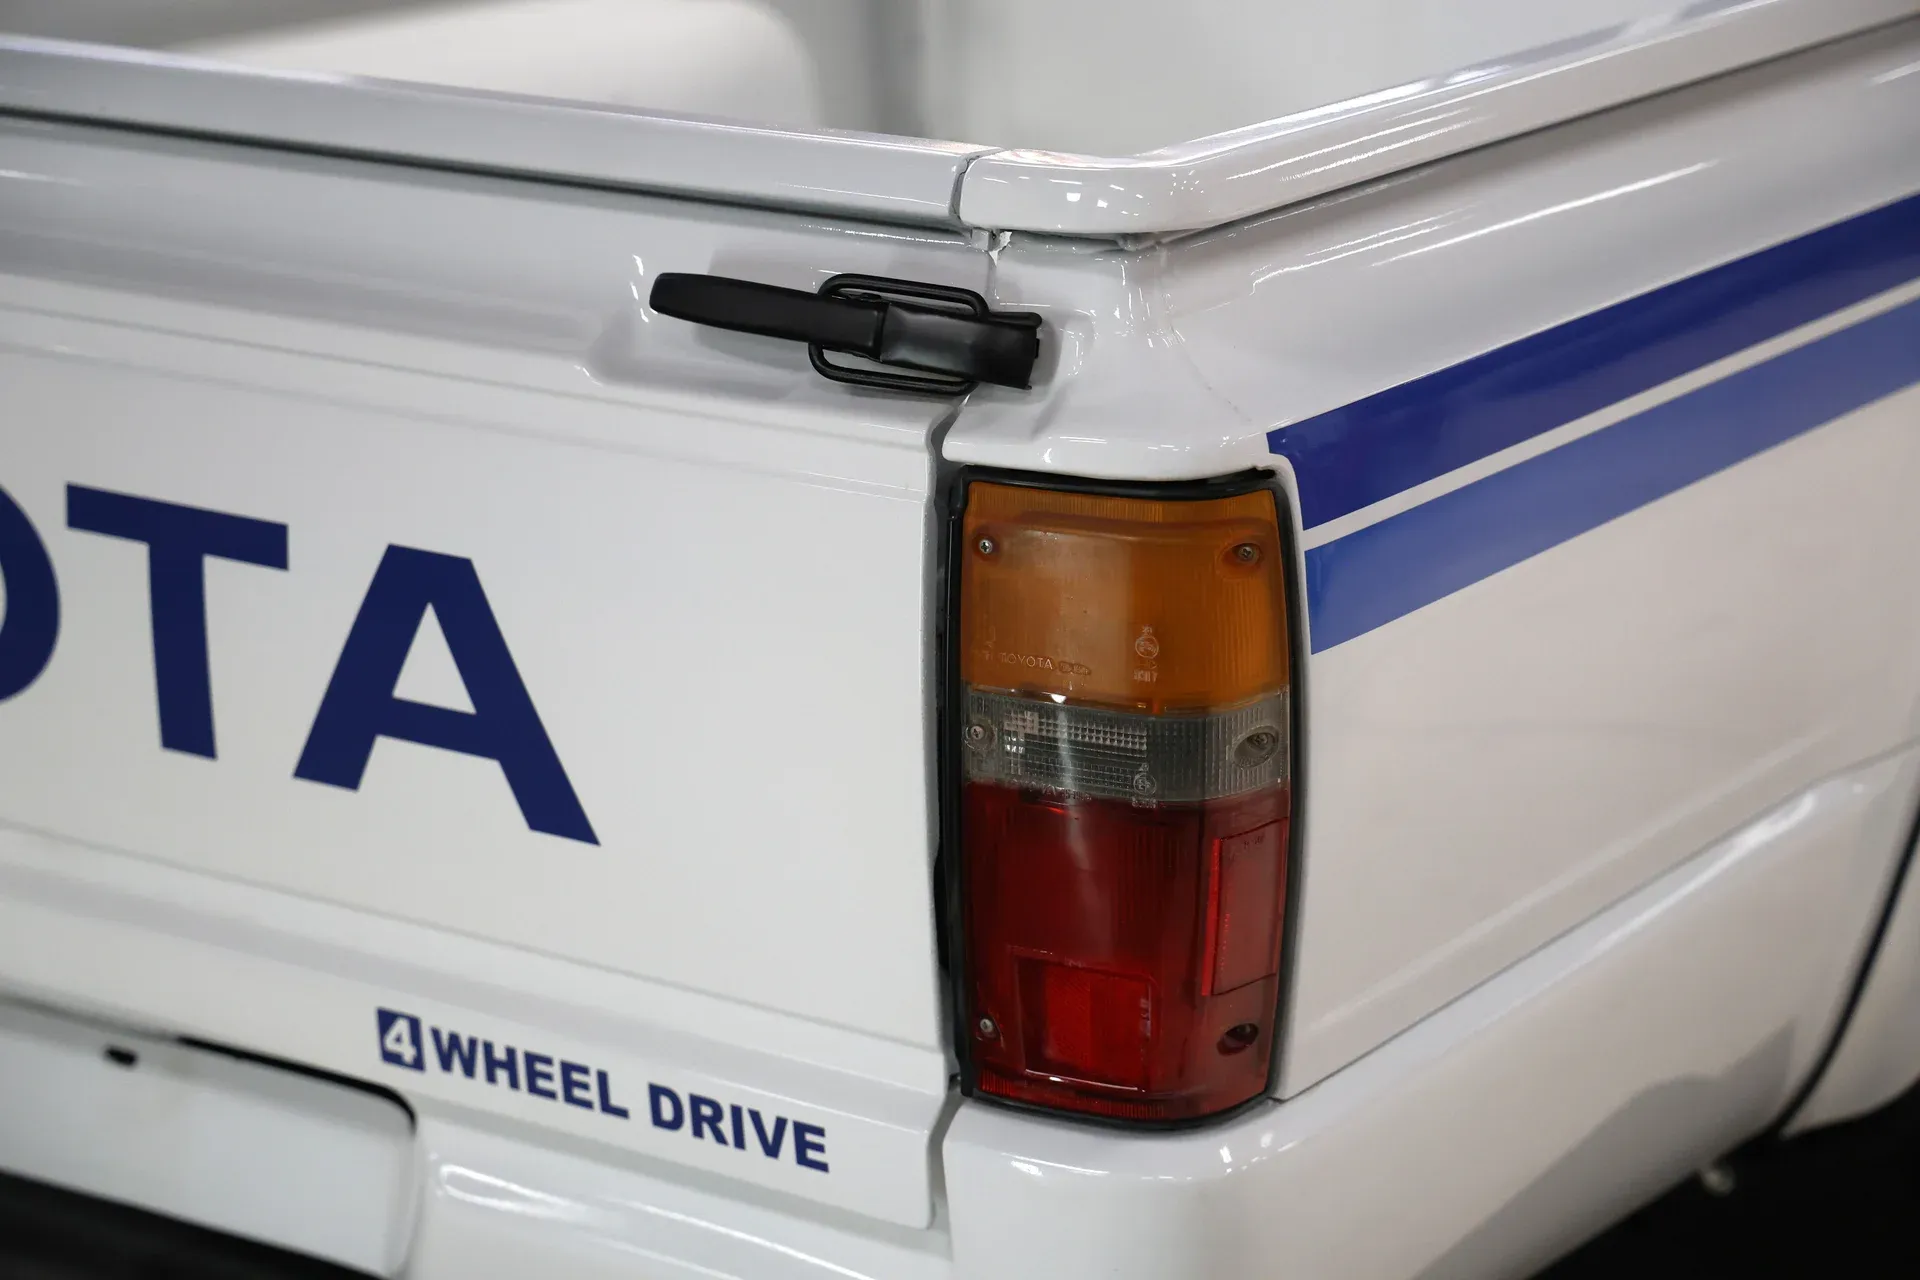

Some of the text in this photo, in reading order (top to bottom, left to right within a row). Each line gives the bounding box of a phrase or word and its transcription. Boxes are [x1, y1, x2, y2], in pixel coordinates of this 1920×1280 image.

[0, 482, 601, 847] TA
[380, 1012, 830, 1174] 4 WHEEL DRIVE
